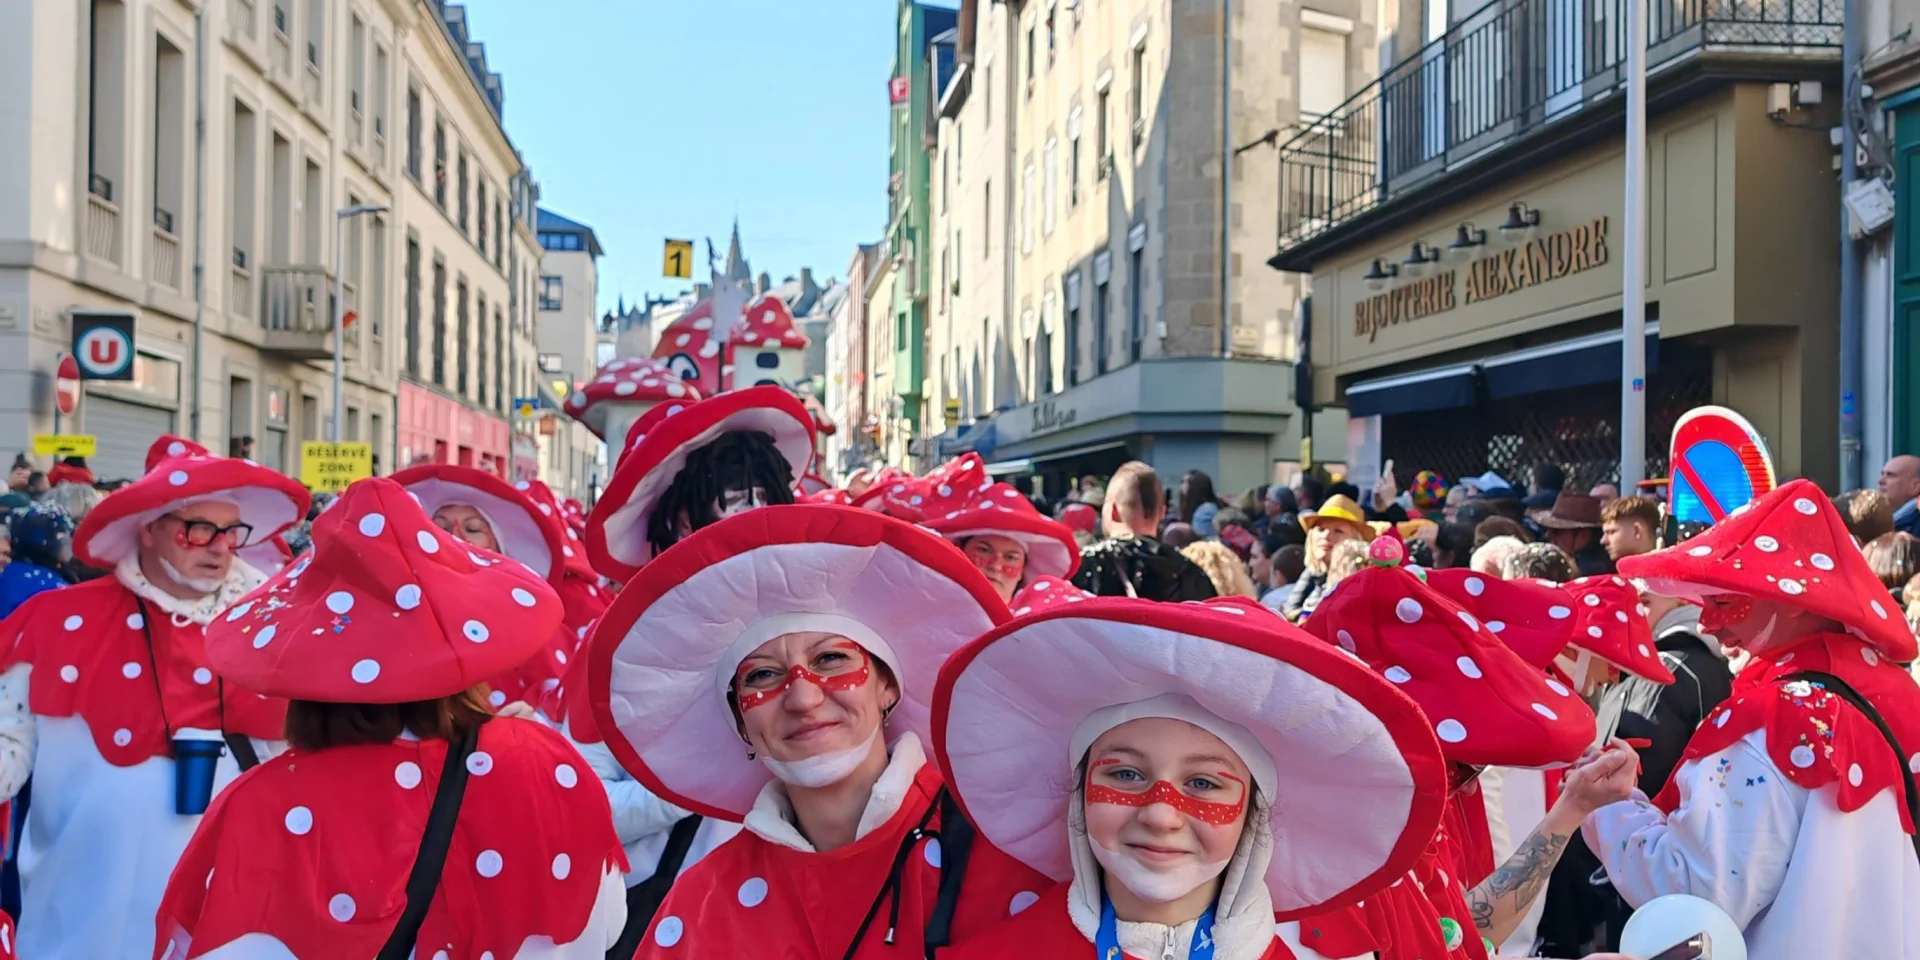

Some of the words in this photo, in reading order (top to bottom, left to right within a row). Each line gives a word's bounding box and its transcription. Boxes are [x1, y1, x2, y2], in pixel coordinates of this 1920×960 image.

[669, 250, 682, 277] 1
[1354, 269, 1456, 343] BIJOUTERIE
[1465, 216, 1608, 305] ALEXANDRE
[91, 340, 118, 365] U
[320, 462, 353, 473] ZONE
